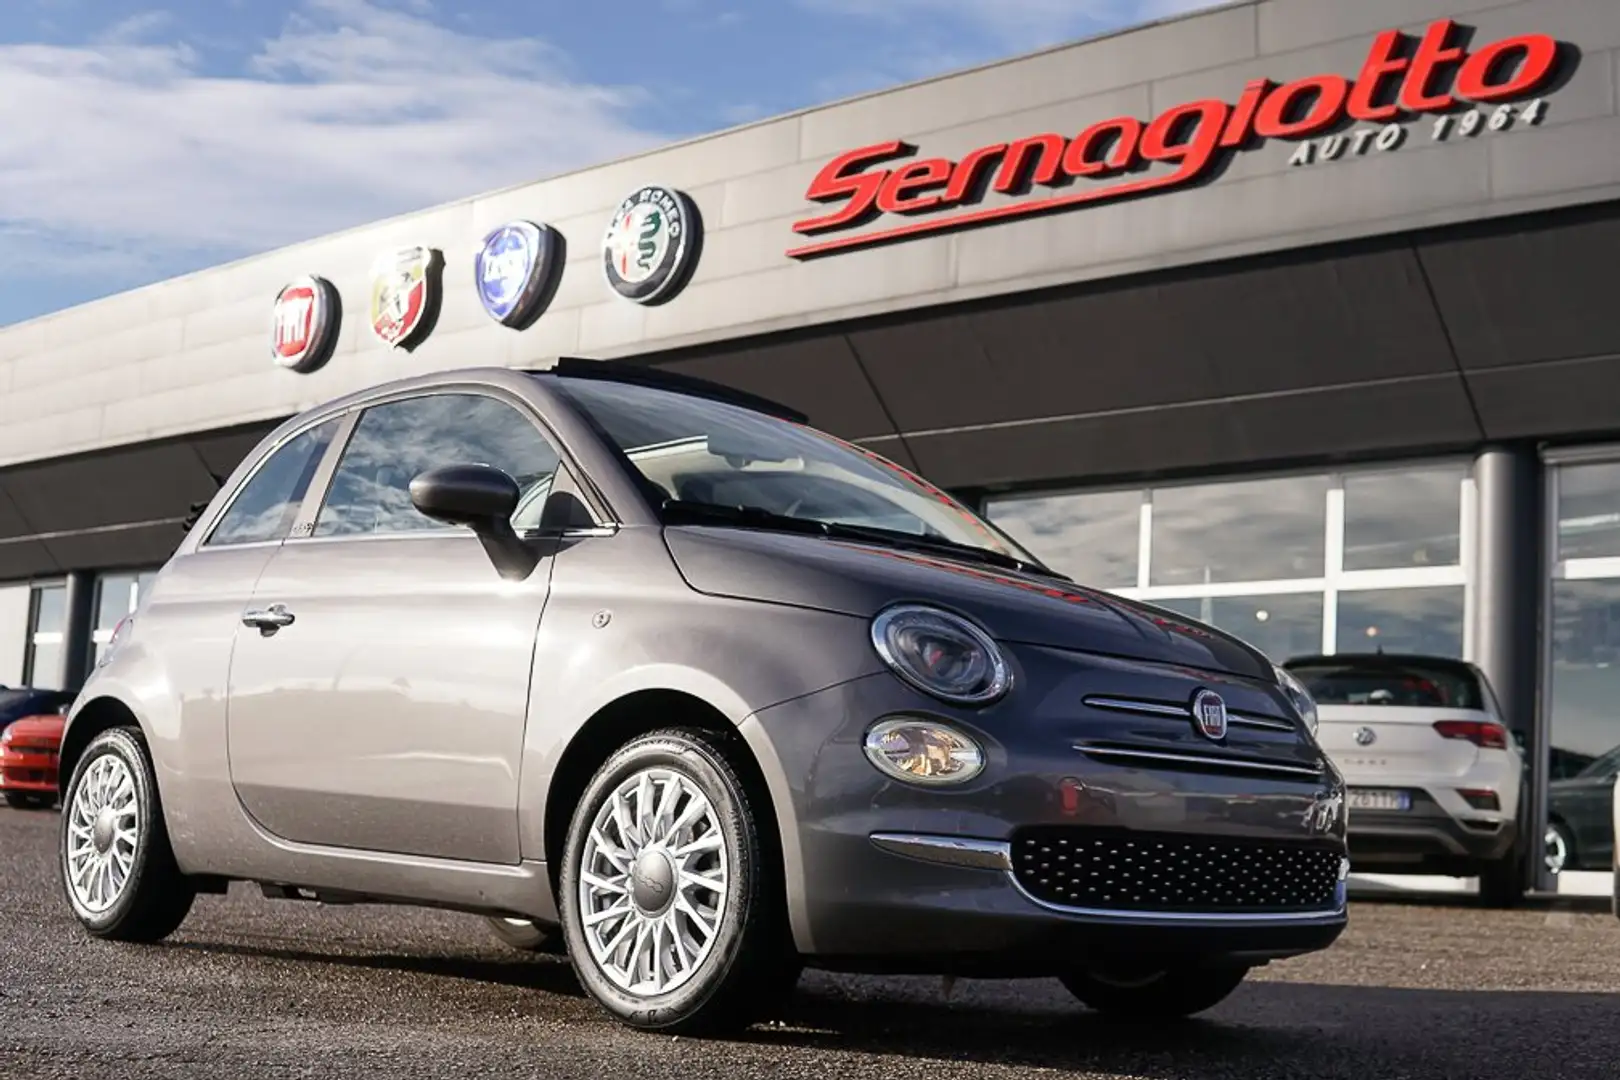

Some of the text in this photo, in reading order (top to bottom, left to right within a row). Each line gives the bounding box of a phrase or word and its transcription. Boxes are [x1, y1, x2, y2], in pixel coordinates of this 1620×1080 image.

[785, 19, 1557, 257] Sernagiotto
[1288, 98, 1542, 165] AUTO 1964
